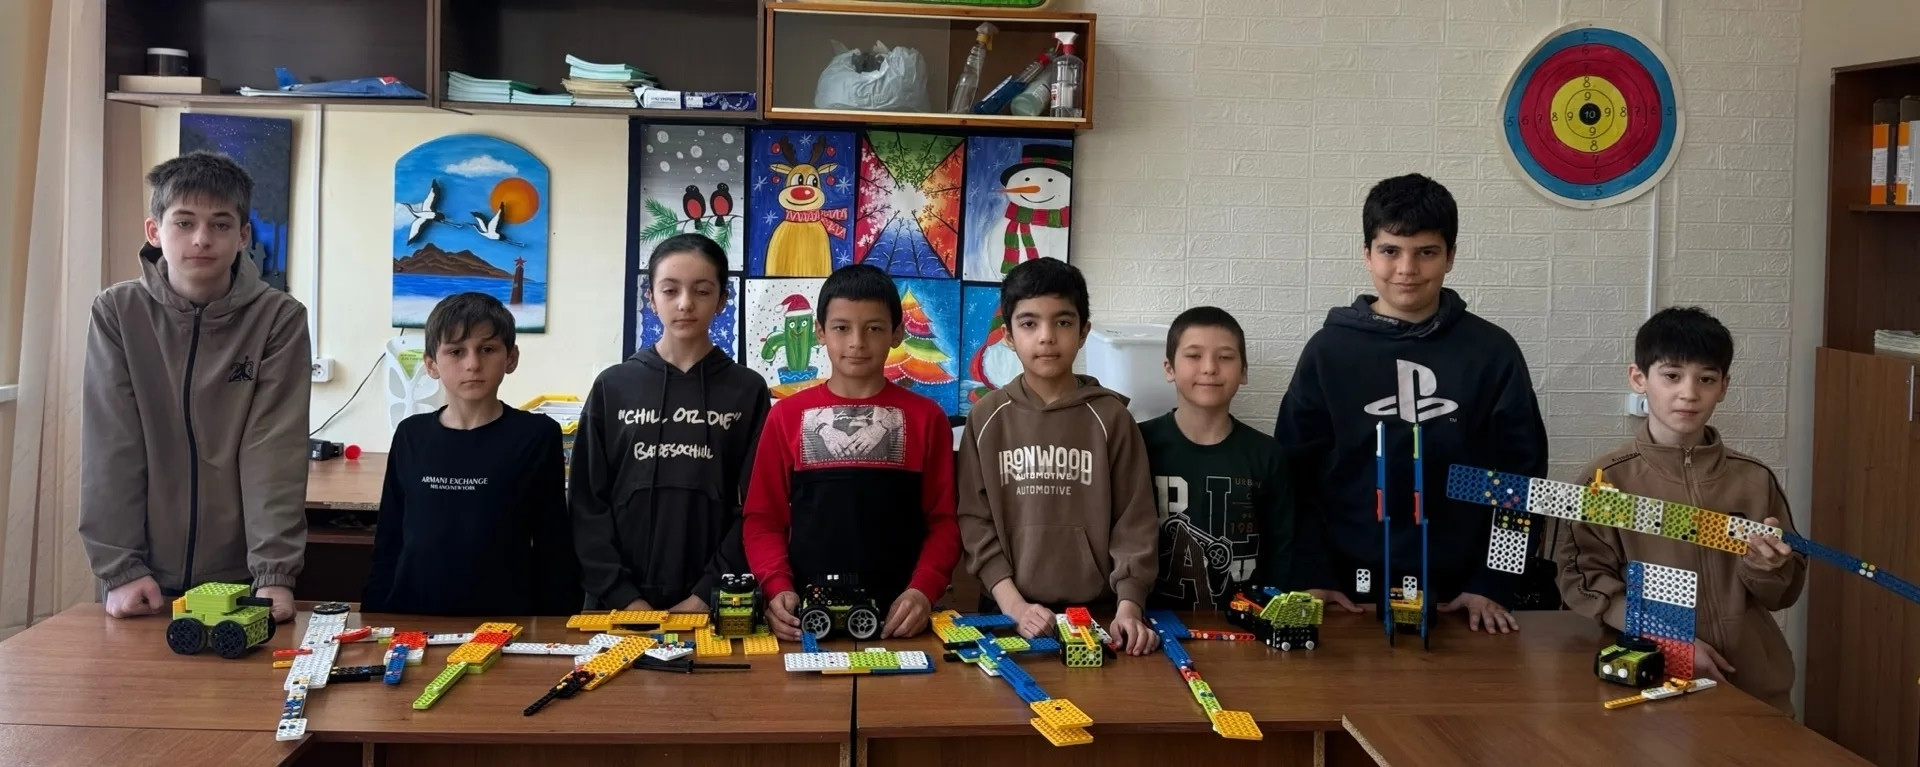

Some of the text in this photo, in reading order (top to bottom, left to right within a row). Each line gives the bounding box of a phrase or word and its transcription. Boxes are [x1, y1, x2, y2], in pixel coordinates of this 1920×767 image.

[1583, 32, 1589, 42] 5
[1583, 76, 1591, 88] 8
[1584, 91, 1592, 101] 9
[1506, 105, 1673, 127] 5 6 7 8 9 10 9 8 7 6 5
[1589, 126, 1597, 136] 9
[1590, 140, 1598, 151] 8
[1594, 185, 1603, 197] 5
[672, 407, 705, 423] OR
[998, 444, 1093, 487] IRONWOOD
[421, 476, 489, 485] ARMANI EXCHANGE
[1015, 471, 1072, 481] AUTOMOTIVE
[1015, 484, 1072, 496] AUTOMOTIVE
